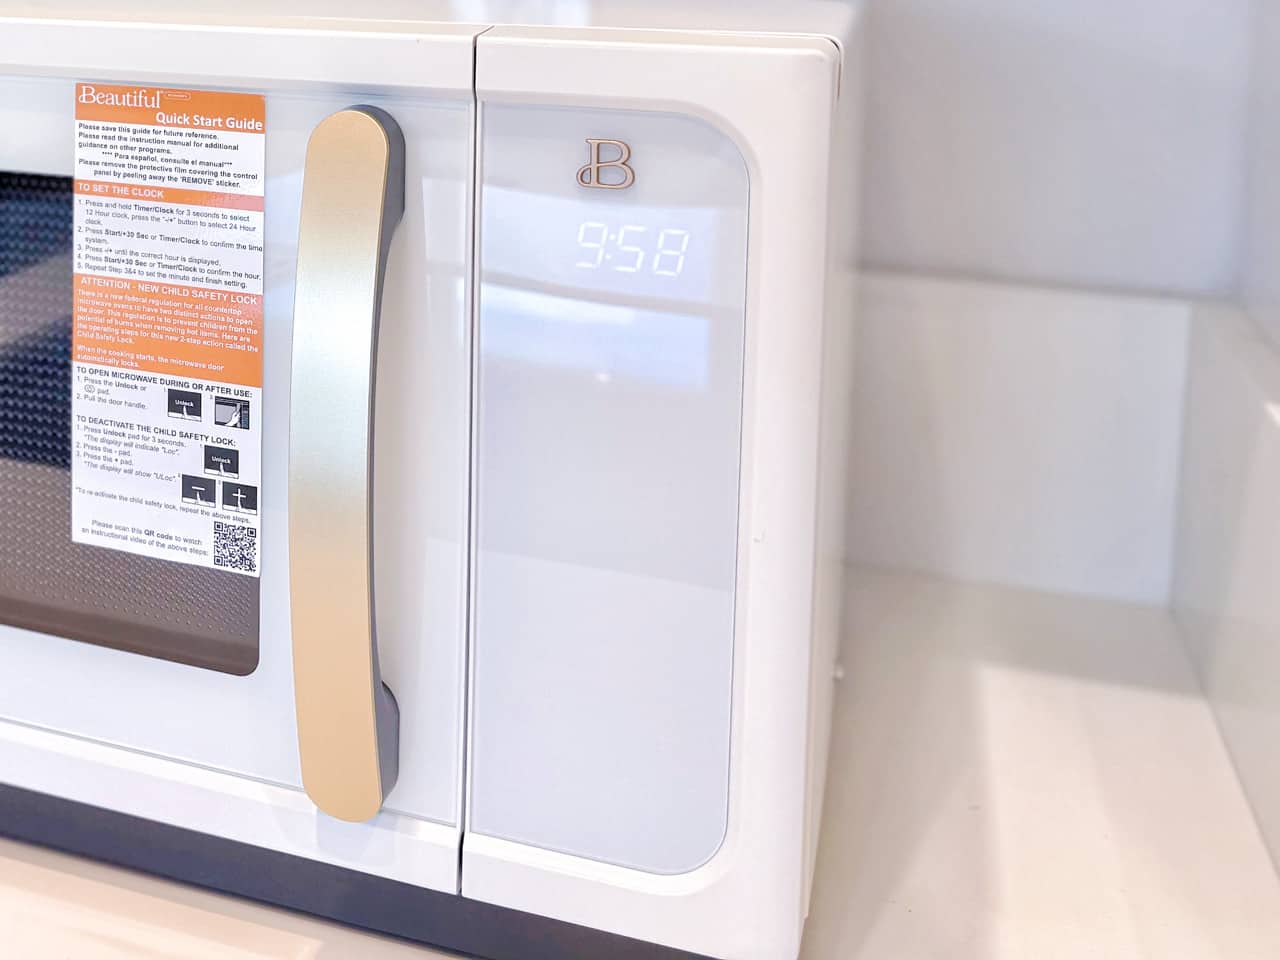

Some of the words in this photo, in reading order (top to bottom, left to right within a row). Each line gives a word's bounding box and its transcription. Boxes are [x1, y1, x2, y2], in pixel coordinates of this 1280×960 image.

[78, 85, 160, 109] Beautiful
[156, 112, 190, 126] Quick
[193, 114, 222, 127] Start
[226, 117, 263, 131] Guide
[101, 133, 116, 141] read
[130, 136, 165, 145] instruction
[167, 139, 191, 147] manual
[205, 142, 239, 151] additional
[132, 127, 150, 136] guide
[185, 131, 219, 140] reference.
[78, 140, 107, 150] guidance
[139, 147, 172, 156] programs.
[79, 158, 99, 166] Please
[139, 163, 172, 174] protective
[188, 168, 218, 178] covering
[233, 172, 258, 180] control
[576, 138, 636, 190] B
[94, 168, 111, 177] panel
[113, 170, 121, 178] by
[123, 171, 147, 181] peeling
[149, 174, 166, 182] away
[216, 179, 240, 188] sticker.
[79, 183, 90, 192] TO
[93, 184, 109, 193] SET
[112, 186, 129, 195] THE
[132, 188, 164, 199] CLOCK
[575, 221, 689, 277] 9:58
[81, 277, 130, 290] ATTENTION
[139, 284, 158, 294] NEW
[162, 286, 188, 298] CHILD
[192, 290, 227, 302] SAFETY
[231, 295, 257, 306] LOCK
[77, 366, 86, 374] TO
[89, 367, 109, 377] OPEN
[112, 371, 157, 384] MICROWAVE
[160, 378, 190, 389] DURING
[192, 382, 203, 391] OR
[205, 384, 232, 395] AFTER
[234, 389, 253, 398] USE:
[77, 415, 86, 423] TO
[89, 416, 134, 430] DEACTIVATE
[136, 424, 151, 433] THE
[154, 427, 177, 437] CHILD
[179, 431, 209, 442] SAFETY
[211, 436, 236, 447] LOCK:
